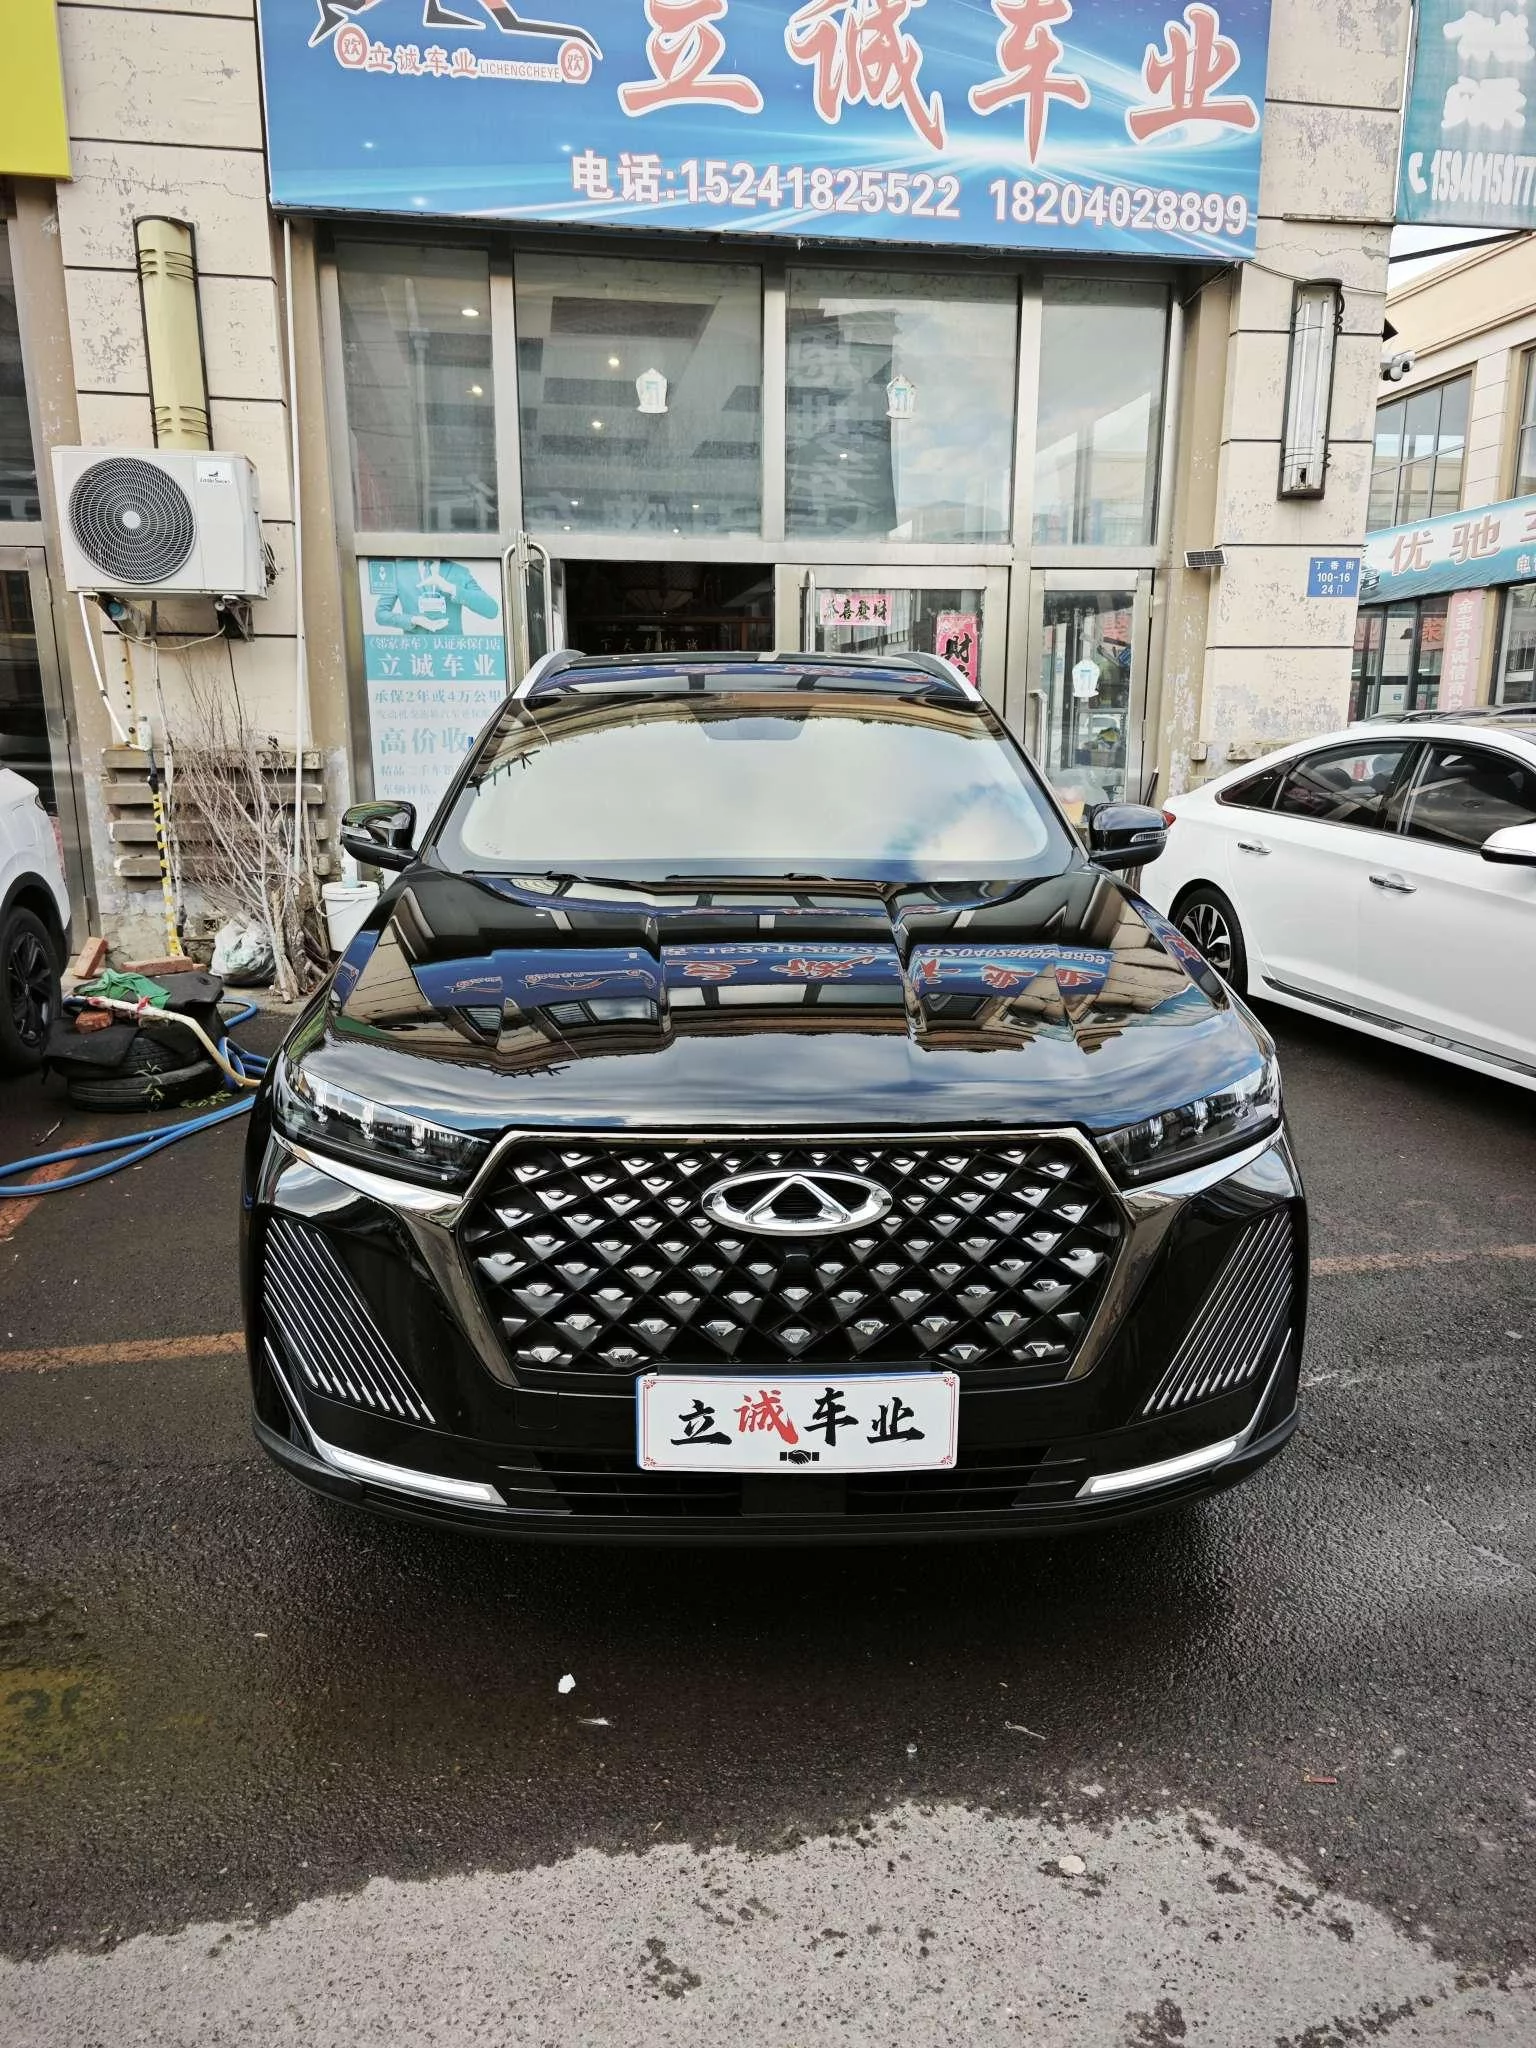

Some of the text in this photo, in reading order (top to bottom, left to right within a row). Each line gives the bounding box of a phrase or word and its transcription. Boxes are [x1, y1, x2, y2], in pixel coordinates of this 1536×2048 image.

[367, 42, 479, 76] 立诚车业
[480, 62, 560, 79] LICHENGCHEYE
[620, 0, 1261, 165] 立诚车业
[990, 178, 1249, 236] 18204028899
[1387, 507, 1536, 576] 优驰
[1317, 572, 1351, 583] 100-16
[377, 653, 497, 678] 立诚车业
[671, 1387, 926, 1446] 立诚车业
